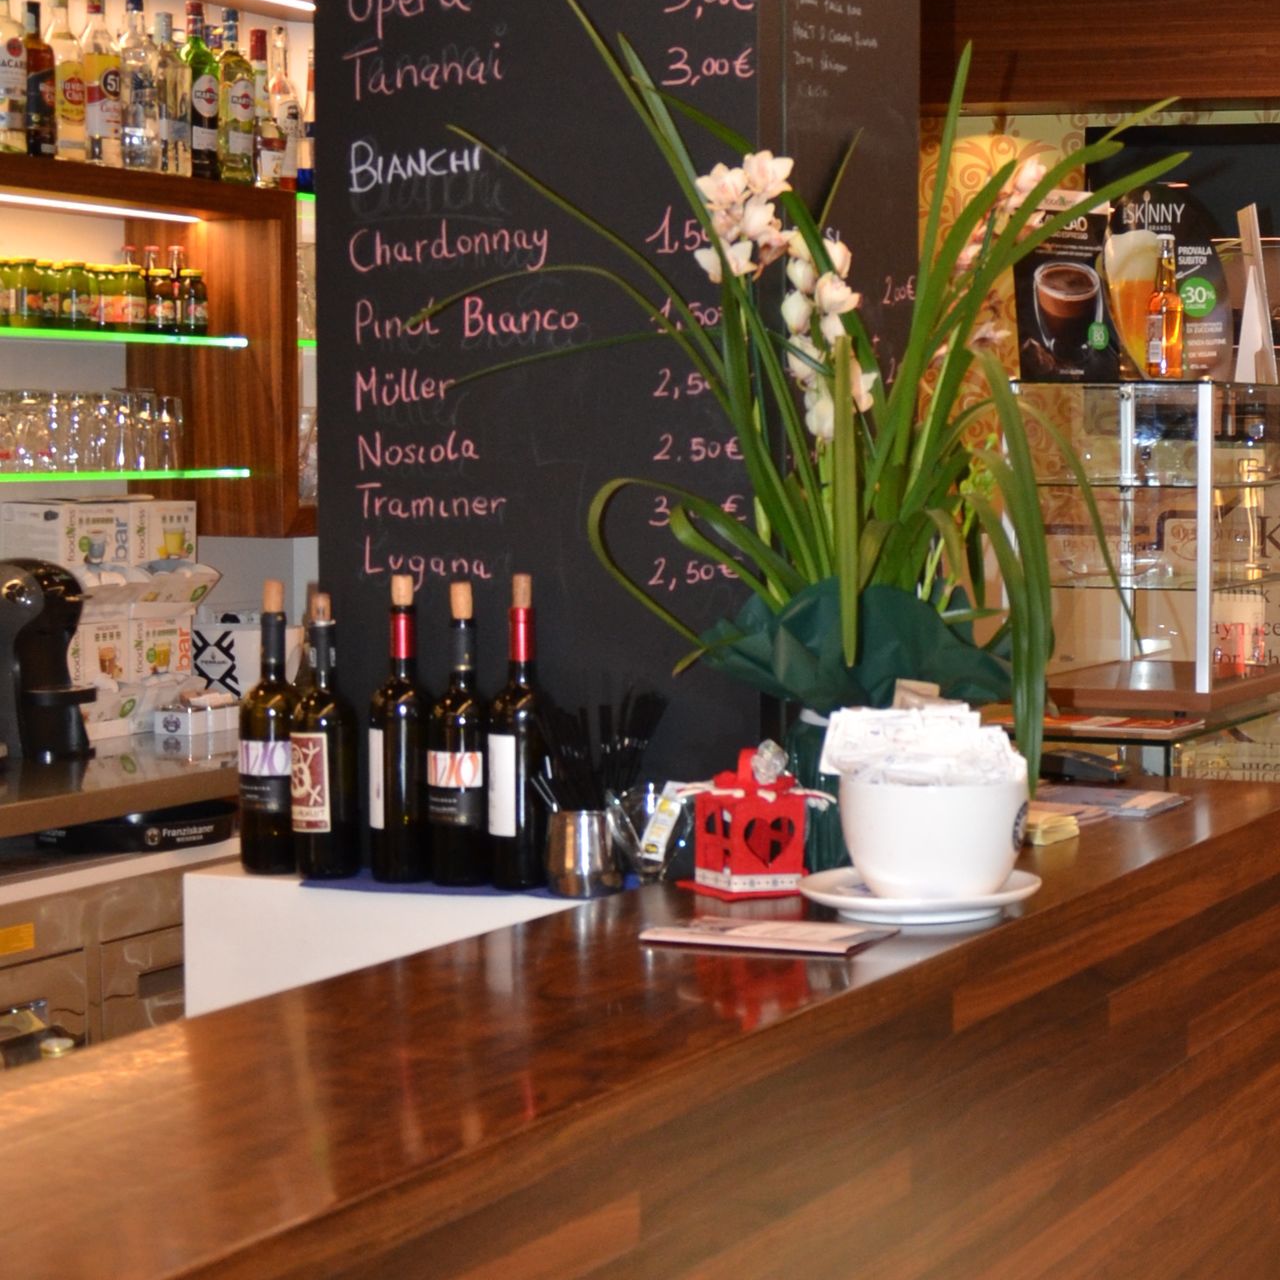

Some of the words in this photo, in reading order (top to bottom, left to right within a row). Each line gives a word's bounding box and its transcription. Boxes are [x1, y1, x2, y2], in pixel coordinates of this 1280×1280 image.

[662, 47, 755, 86] 3,00€
[349, 141, 481, 193] BIANCHI
[350, 219, 548, 272] Chardonnay
[464, 296, 579, 338] Bianco
[355, 367, 454, 412] Müller
[358, 430, 479, 470] Nosiola
[355, 482, 506, 518] Traminer
[365, 536, 492, 591] Lugana
[176, 627, 192, 672] bar
